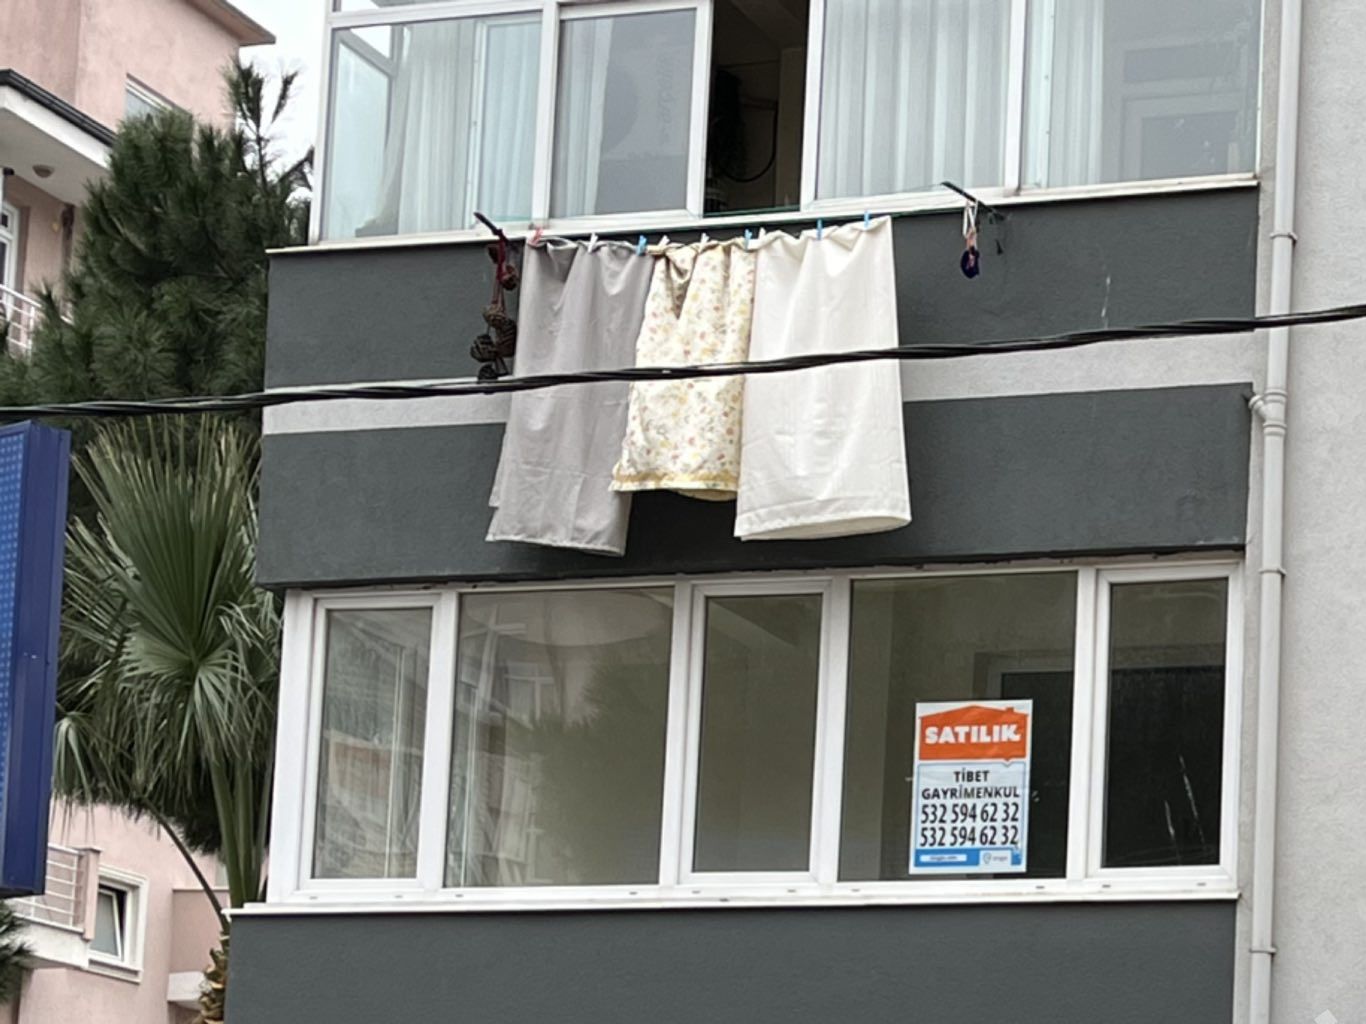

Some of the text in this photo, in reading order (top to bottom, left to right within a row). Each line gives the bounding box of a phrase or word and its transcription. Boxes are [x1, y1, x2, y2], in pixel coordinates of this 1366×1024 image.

[924, 724, 1021, 744] SATILIK
[953, 767, 990, 783] TİBET
[921, 784, 1020, 800] GAYRİMENKUL
[921, 801, 1020, 824] 532 594 62 32
[919, 824, 1019, 847] 532 594 62 32
